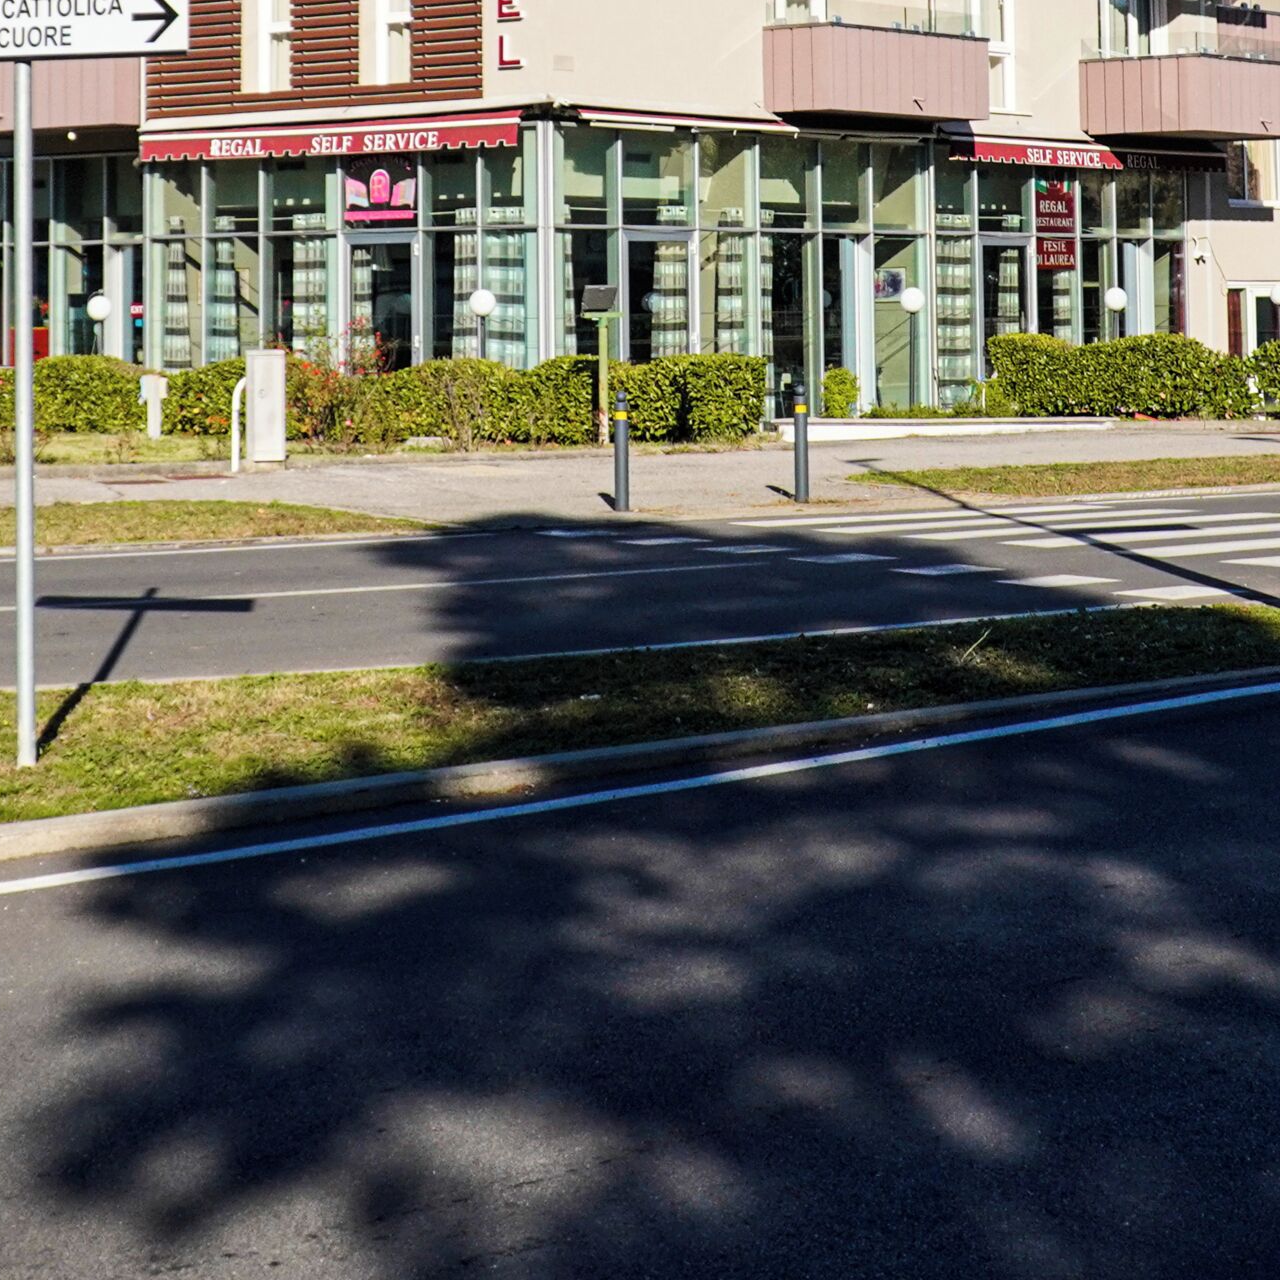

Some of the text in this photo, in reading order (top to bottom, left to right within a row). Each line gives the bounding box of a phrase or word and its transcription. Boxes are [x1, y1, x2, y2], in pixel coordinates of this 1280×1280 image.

[210, 131, 440, 157] REGAL SELF SERVICE
[1026, 148, 1102, 167] SELF SERVICE
[1039, 200, 1068, 214] REGAL
[1043, 241, 1067, 252] FESTE
[1044, 254, 1075, 266] LAUREA
